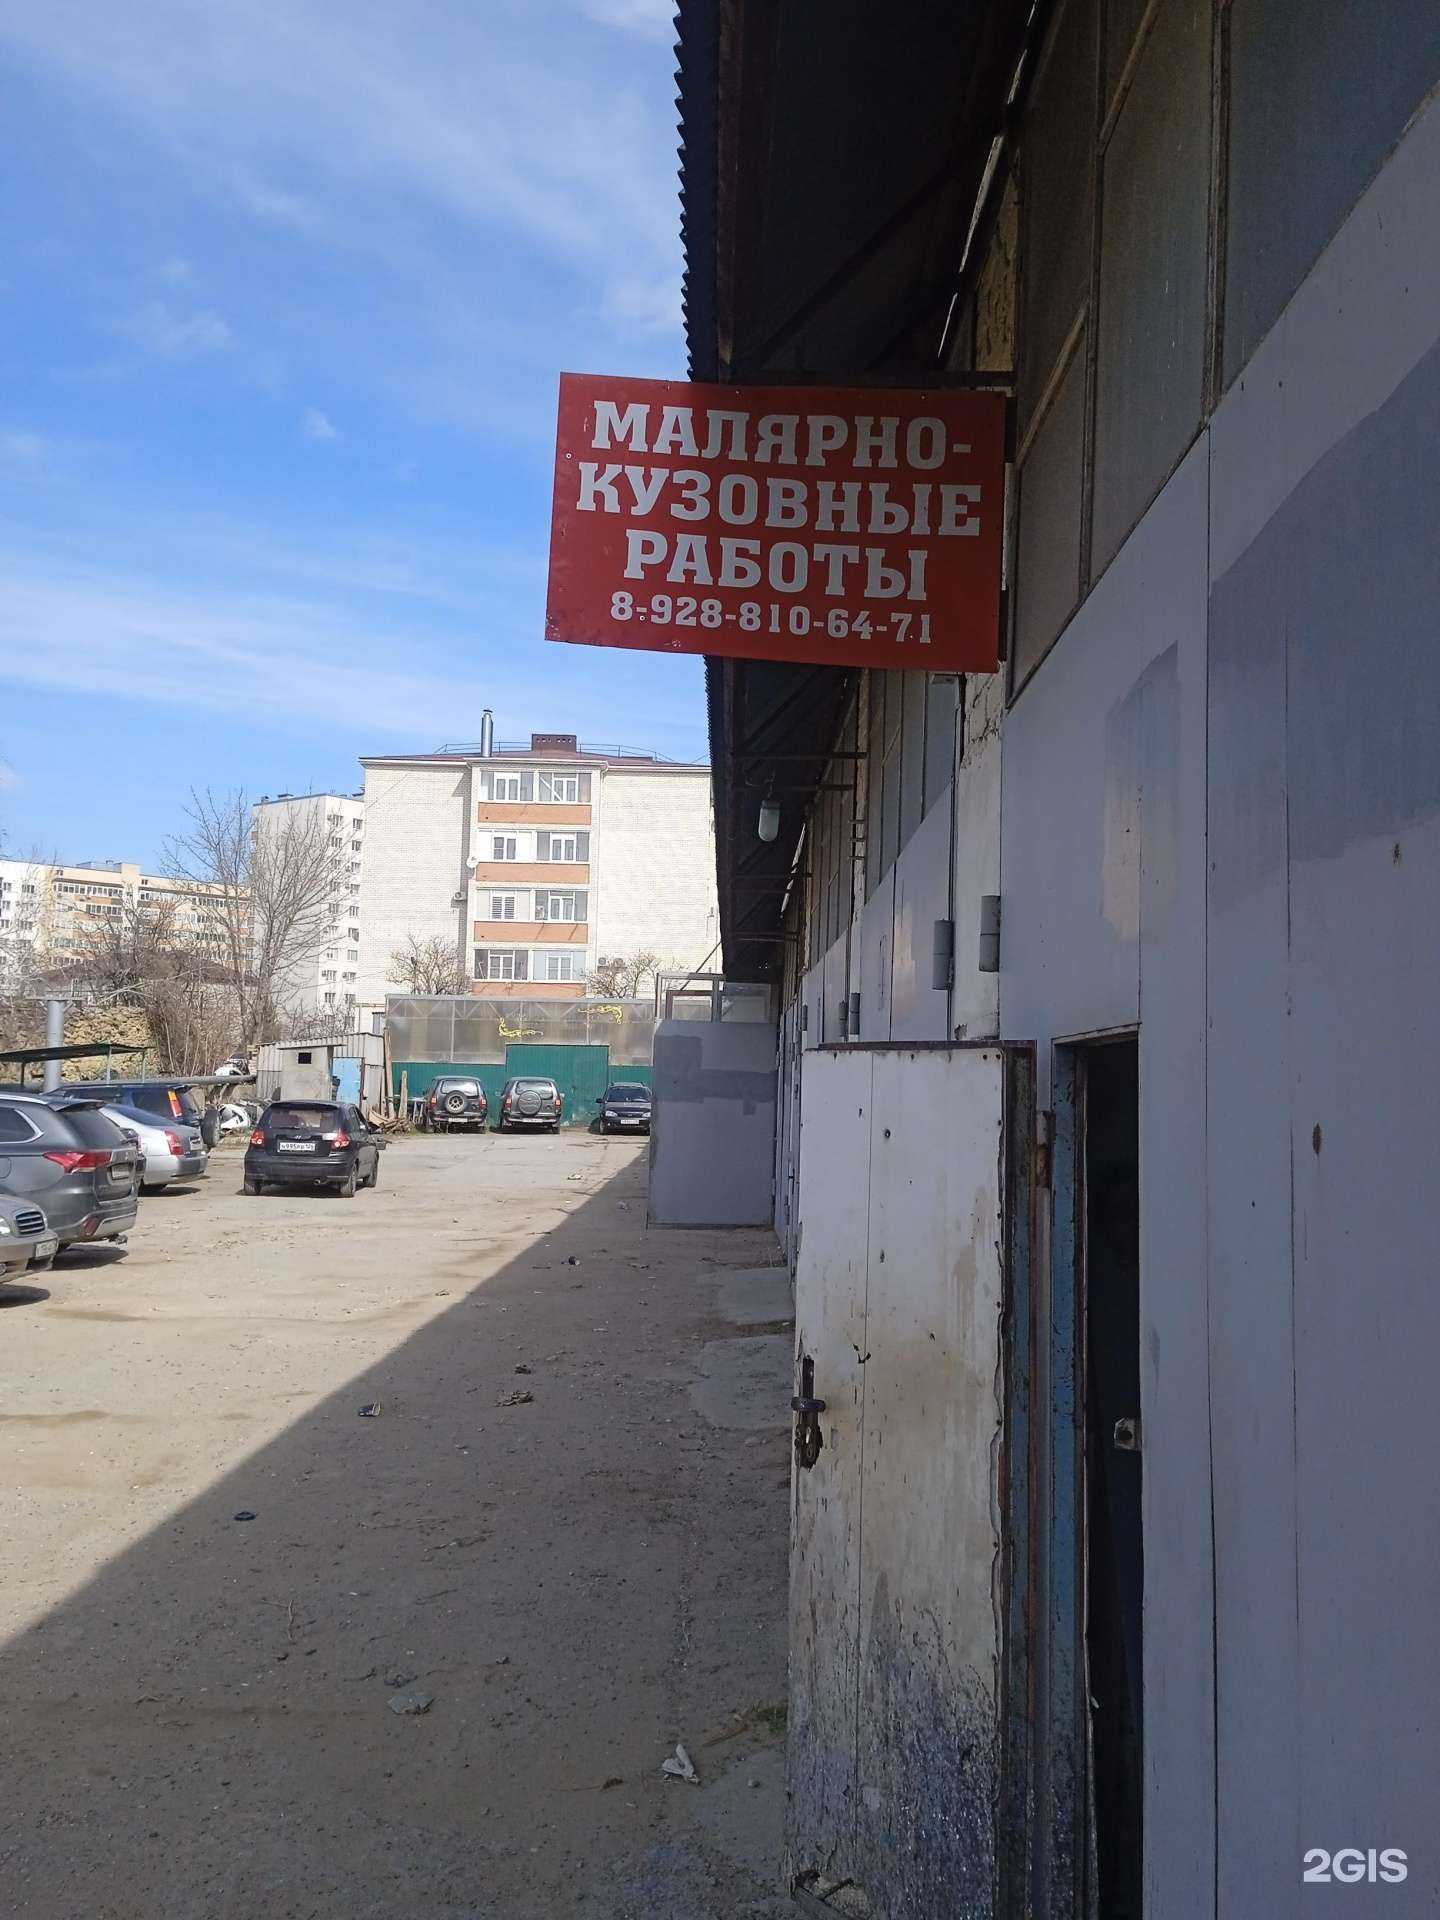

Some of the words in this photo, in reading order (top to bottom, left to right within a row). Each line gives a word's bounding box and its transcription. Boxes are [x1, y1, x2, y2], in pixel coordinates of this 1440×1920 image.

[590, 400, 972, 469] МАЛЯРНО-
[576, 462, 981, 536] КУЗОВНЫЕ
[623, 529, 928, 600] РАБОТЫ
[610, 591, 932, 643] 8-928-810-64-71
